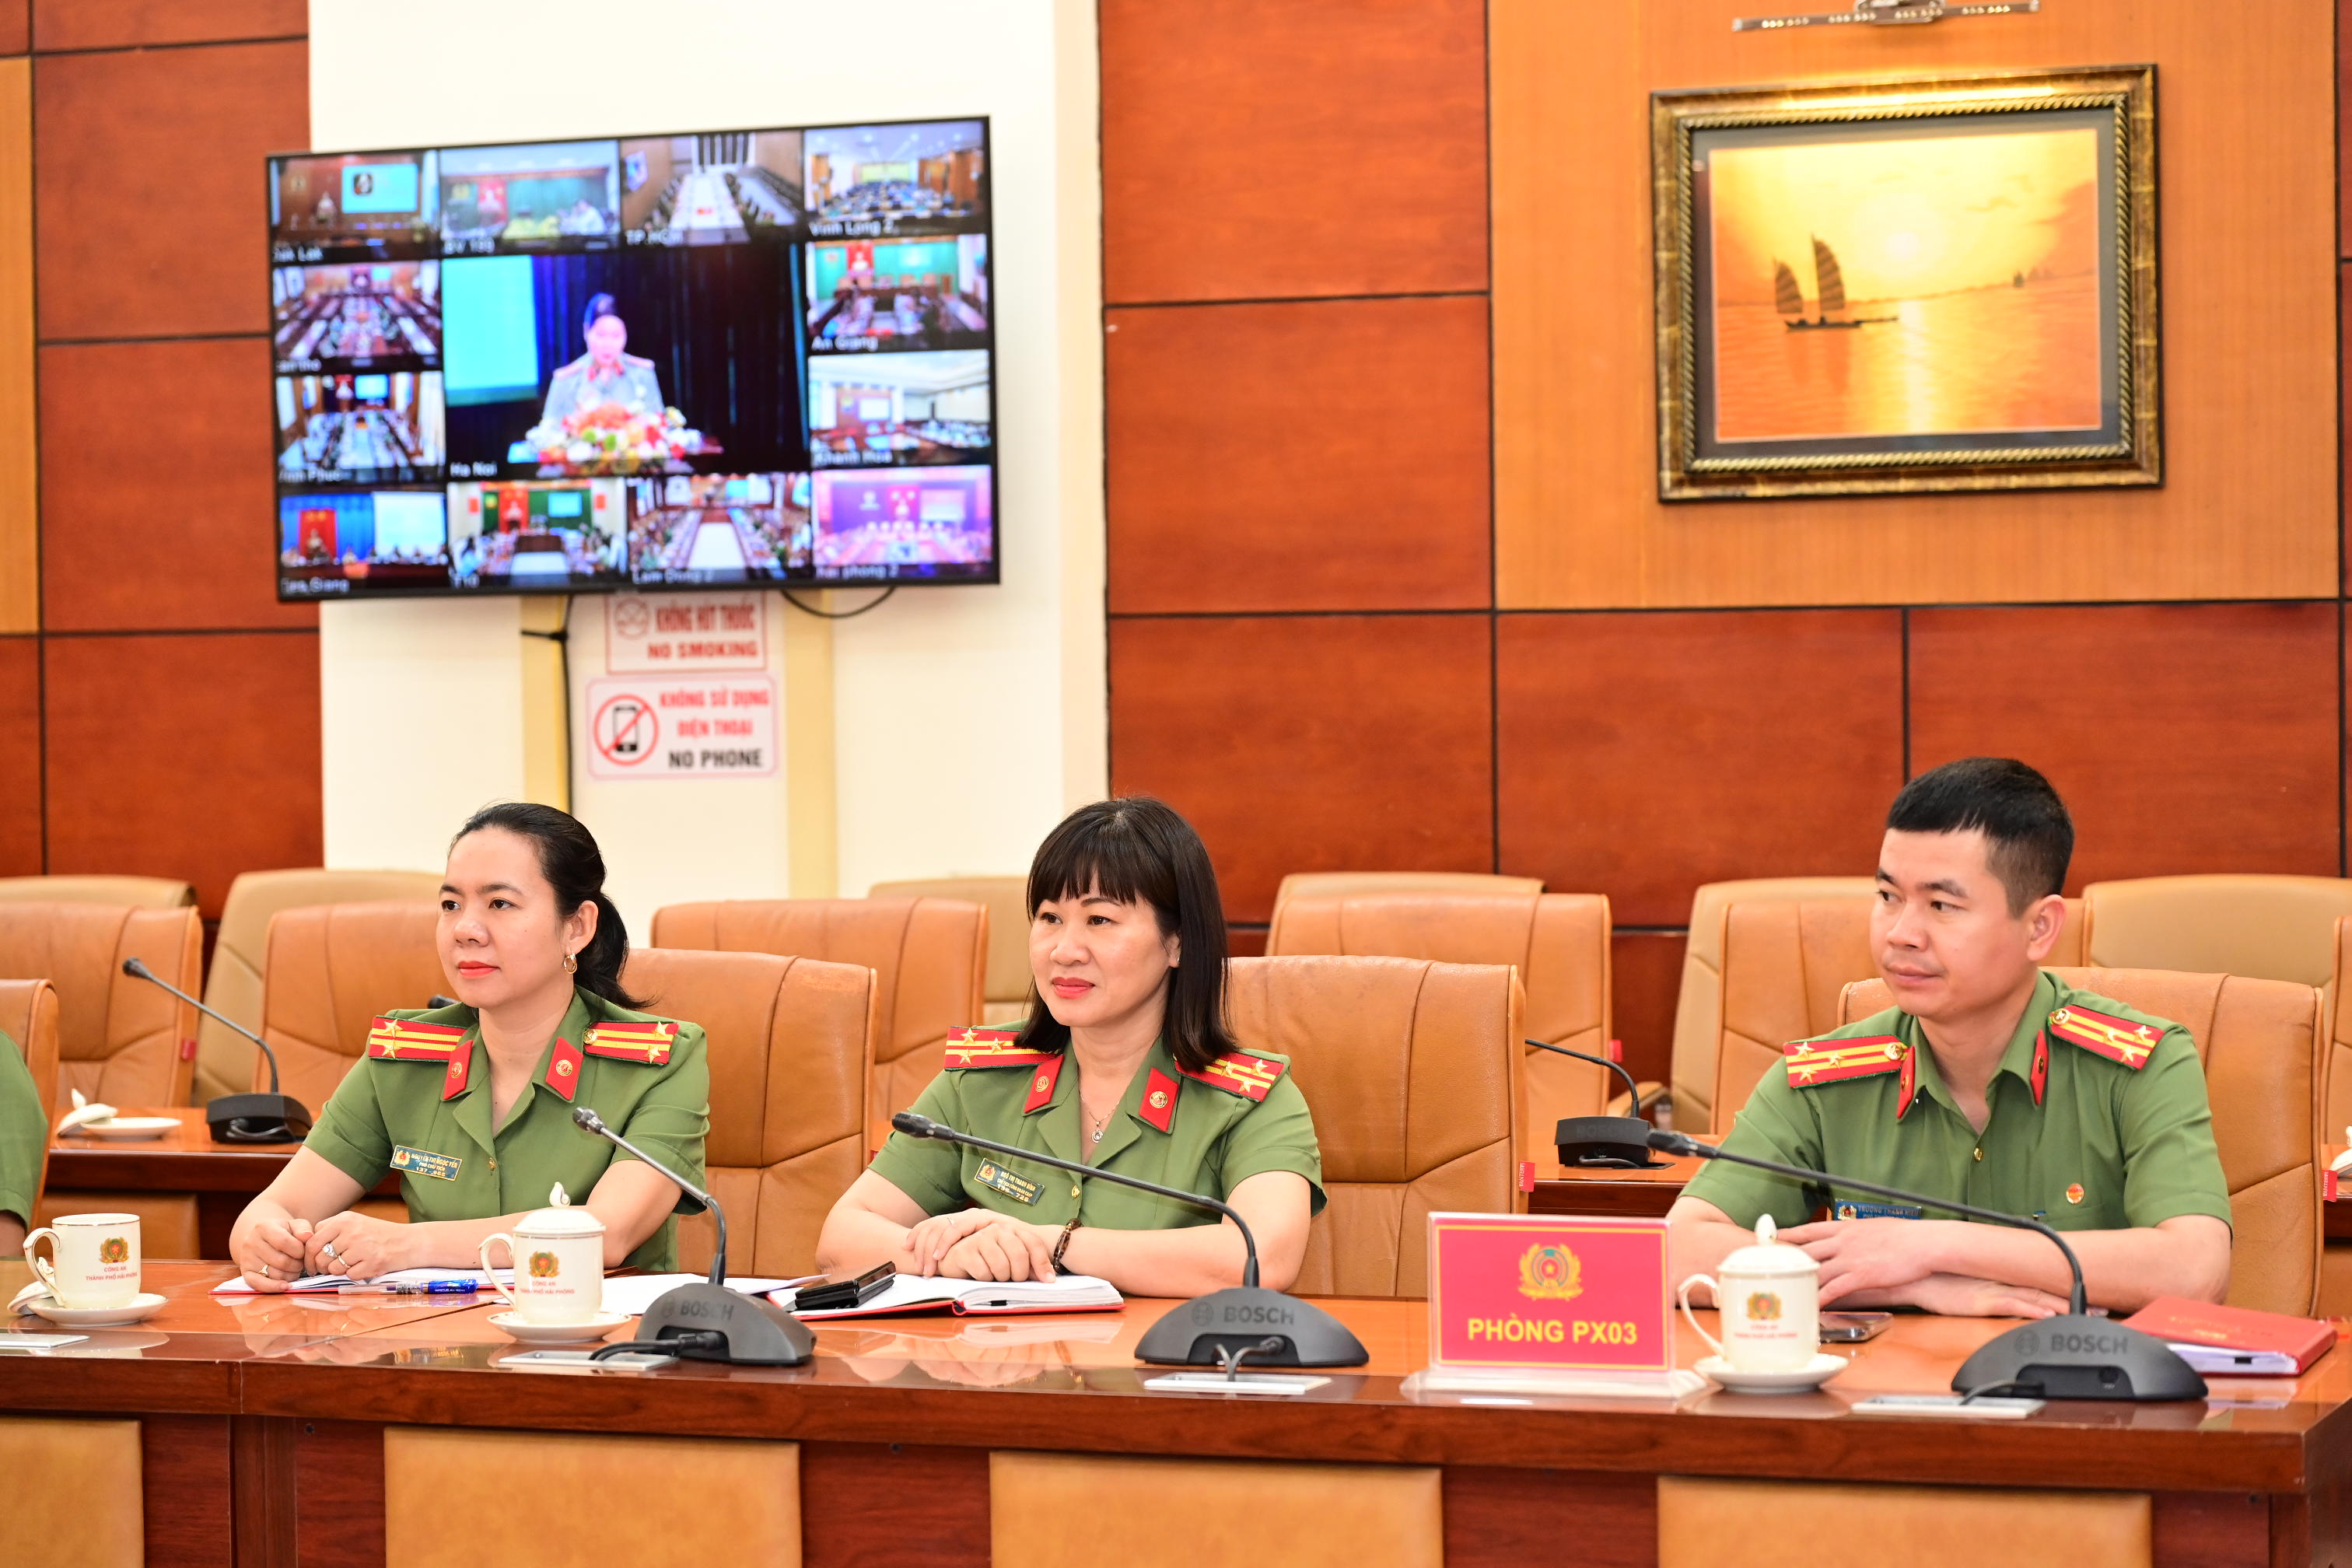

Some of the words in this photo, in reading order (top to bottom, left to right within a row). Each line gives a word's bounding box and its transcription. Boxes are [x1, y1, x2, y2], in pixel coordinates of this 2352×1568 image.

[647, 642, 671, 659] NO
[677, 641, 758, 659] SMOKING
[669, 750, 694, 768] NO
[702, 748, 762, 768] PHONE
[680, 1299, 734, 1321] BOSCH
[1224, 1306, 1294, 1325] BOSCH
[1467, 1311, 1564, 1343] PHÒNG
[1572, 1319, 1638, 1345] PX03
[2050, 1333, 2128, 1355] BOSCH
